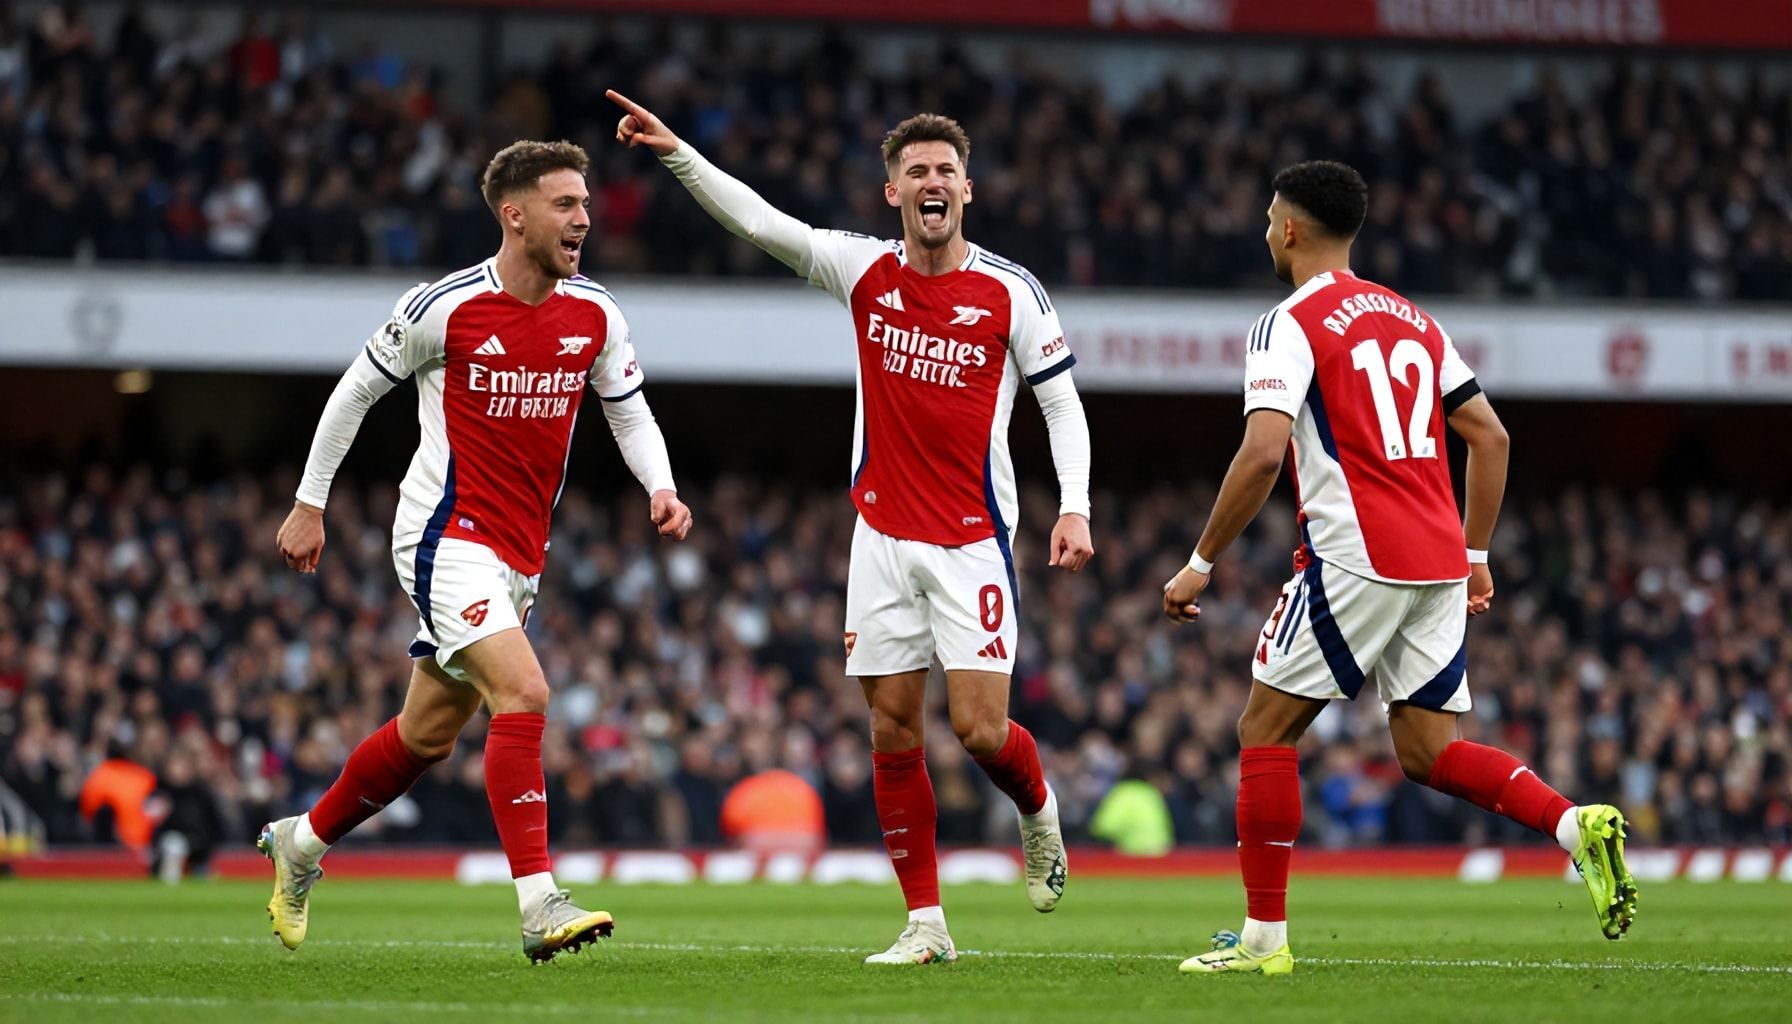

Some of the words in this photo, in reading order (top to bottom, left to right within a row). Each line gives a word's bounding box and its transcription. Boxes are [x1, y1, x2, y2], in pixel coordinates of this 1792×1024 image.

[868, 312, 987, 367] Emirates
[468, 362, 588, 394] Emirates
[1350, 338, 1438, 461] 12
